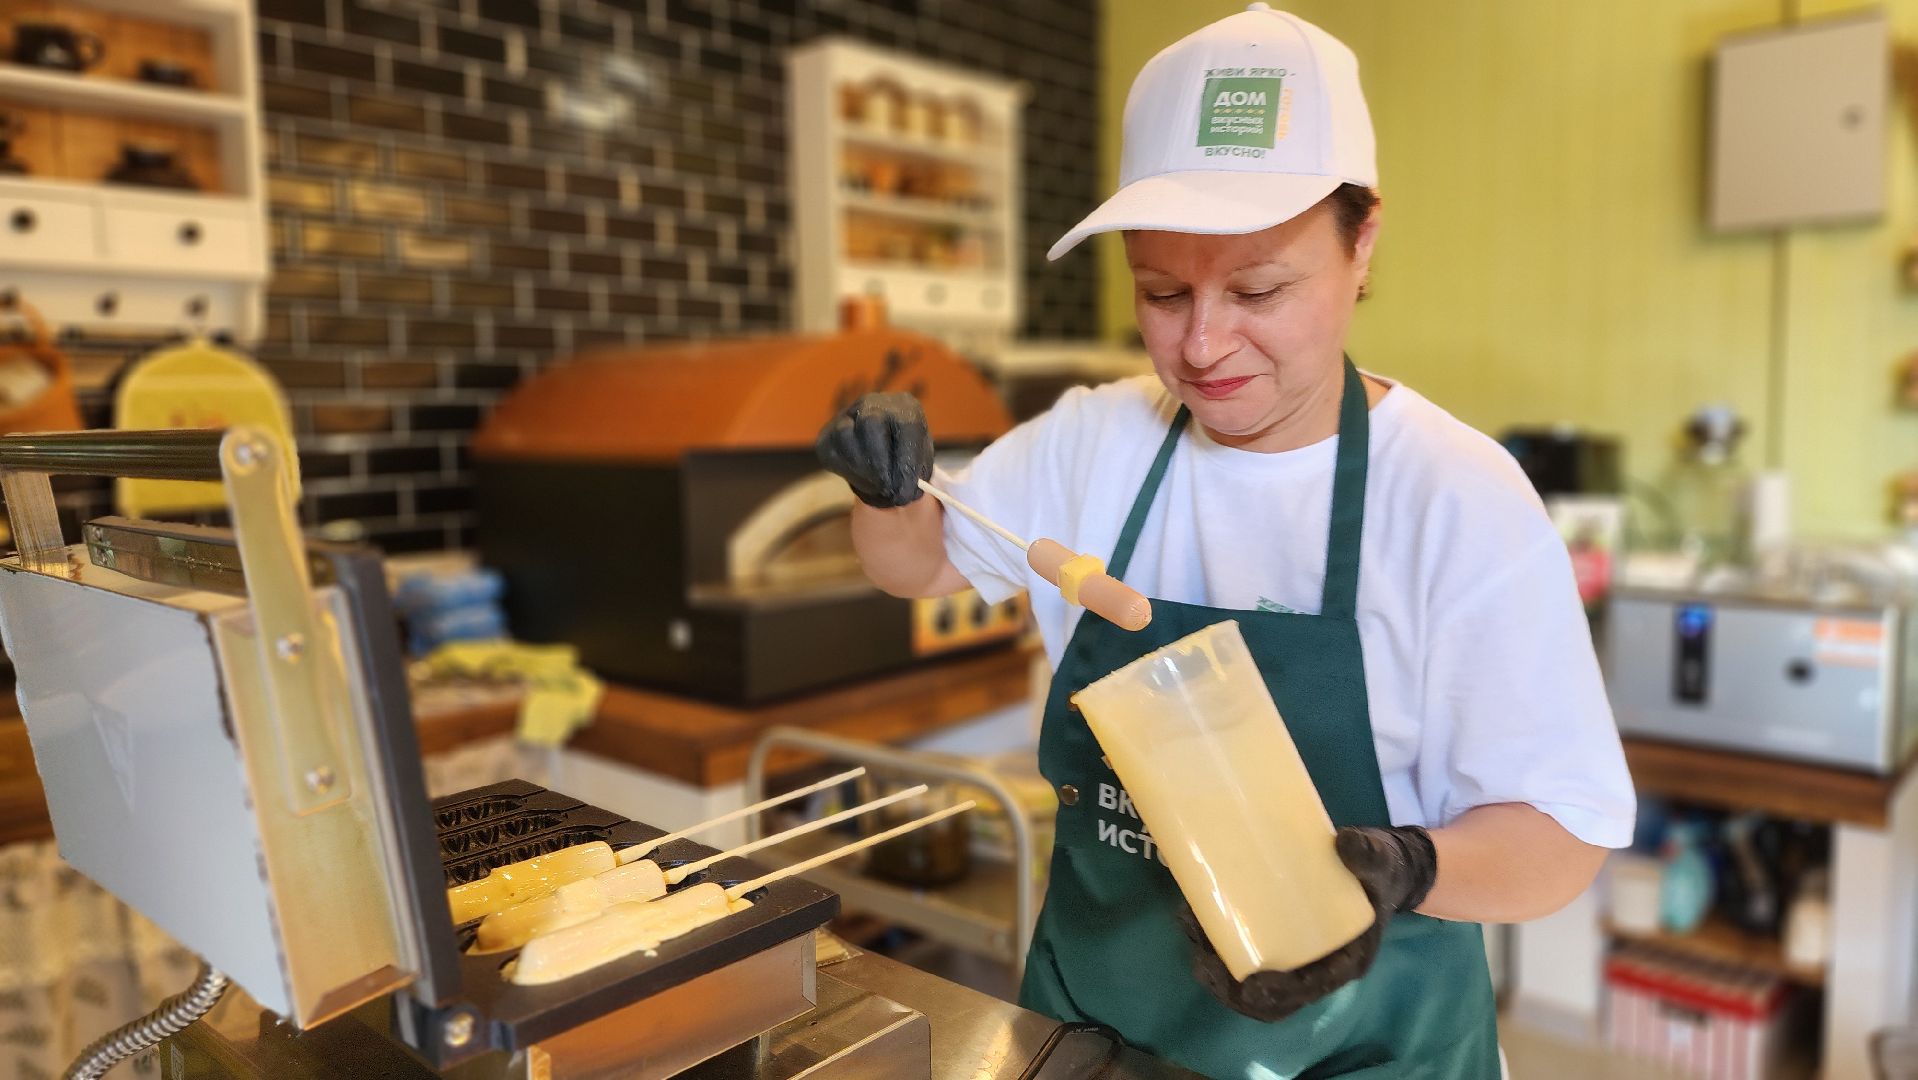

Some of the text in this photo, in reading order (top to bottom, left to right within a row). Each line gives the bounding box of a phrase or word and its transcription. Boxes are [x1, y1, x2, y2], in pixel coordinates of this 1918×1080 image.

[1205, 67, 1245, 78] ЖИВИ
[1248, 67, 1287, 77] ЯРКО
[1213, 91, 1267, 107] ДОМ
[1211, 117, 1264, 126] вкусных
[1210, 125, 1264, 136] историй
[1205, 147, 1266, 159] ВКУСНО!
[1098, 818, 1168, 868] ИСТ
